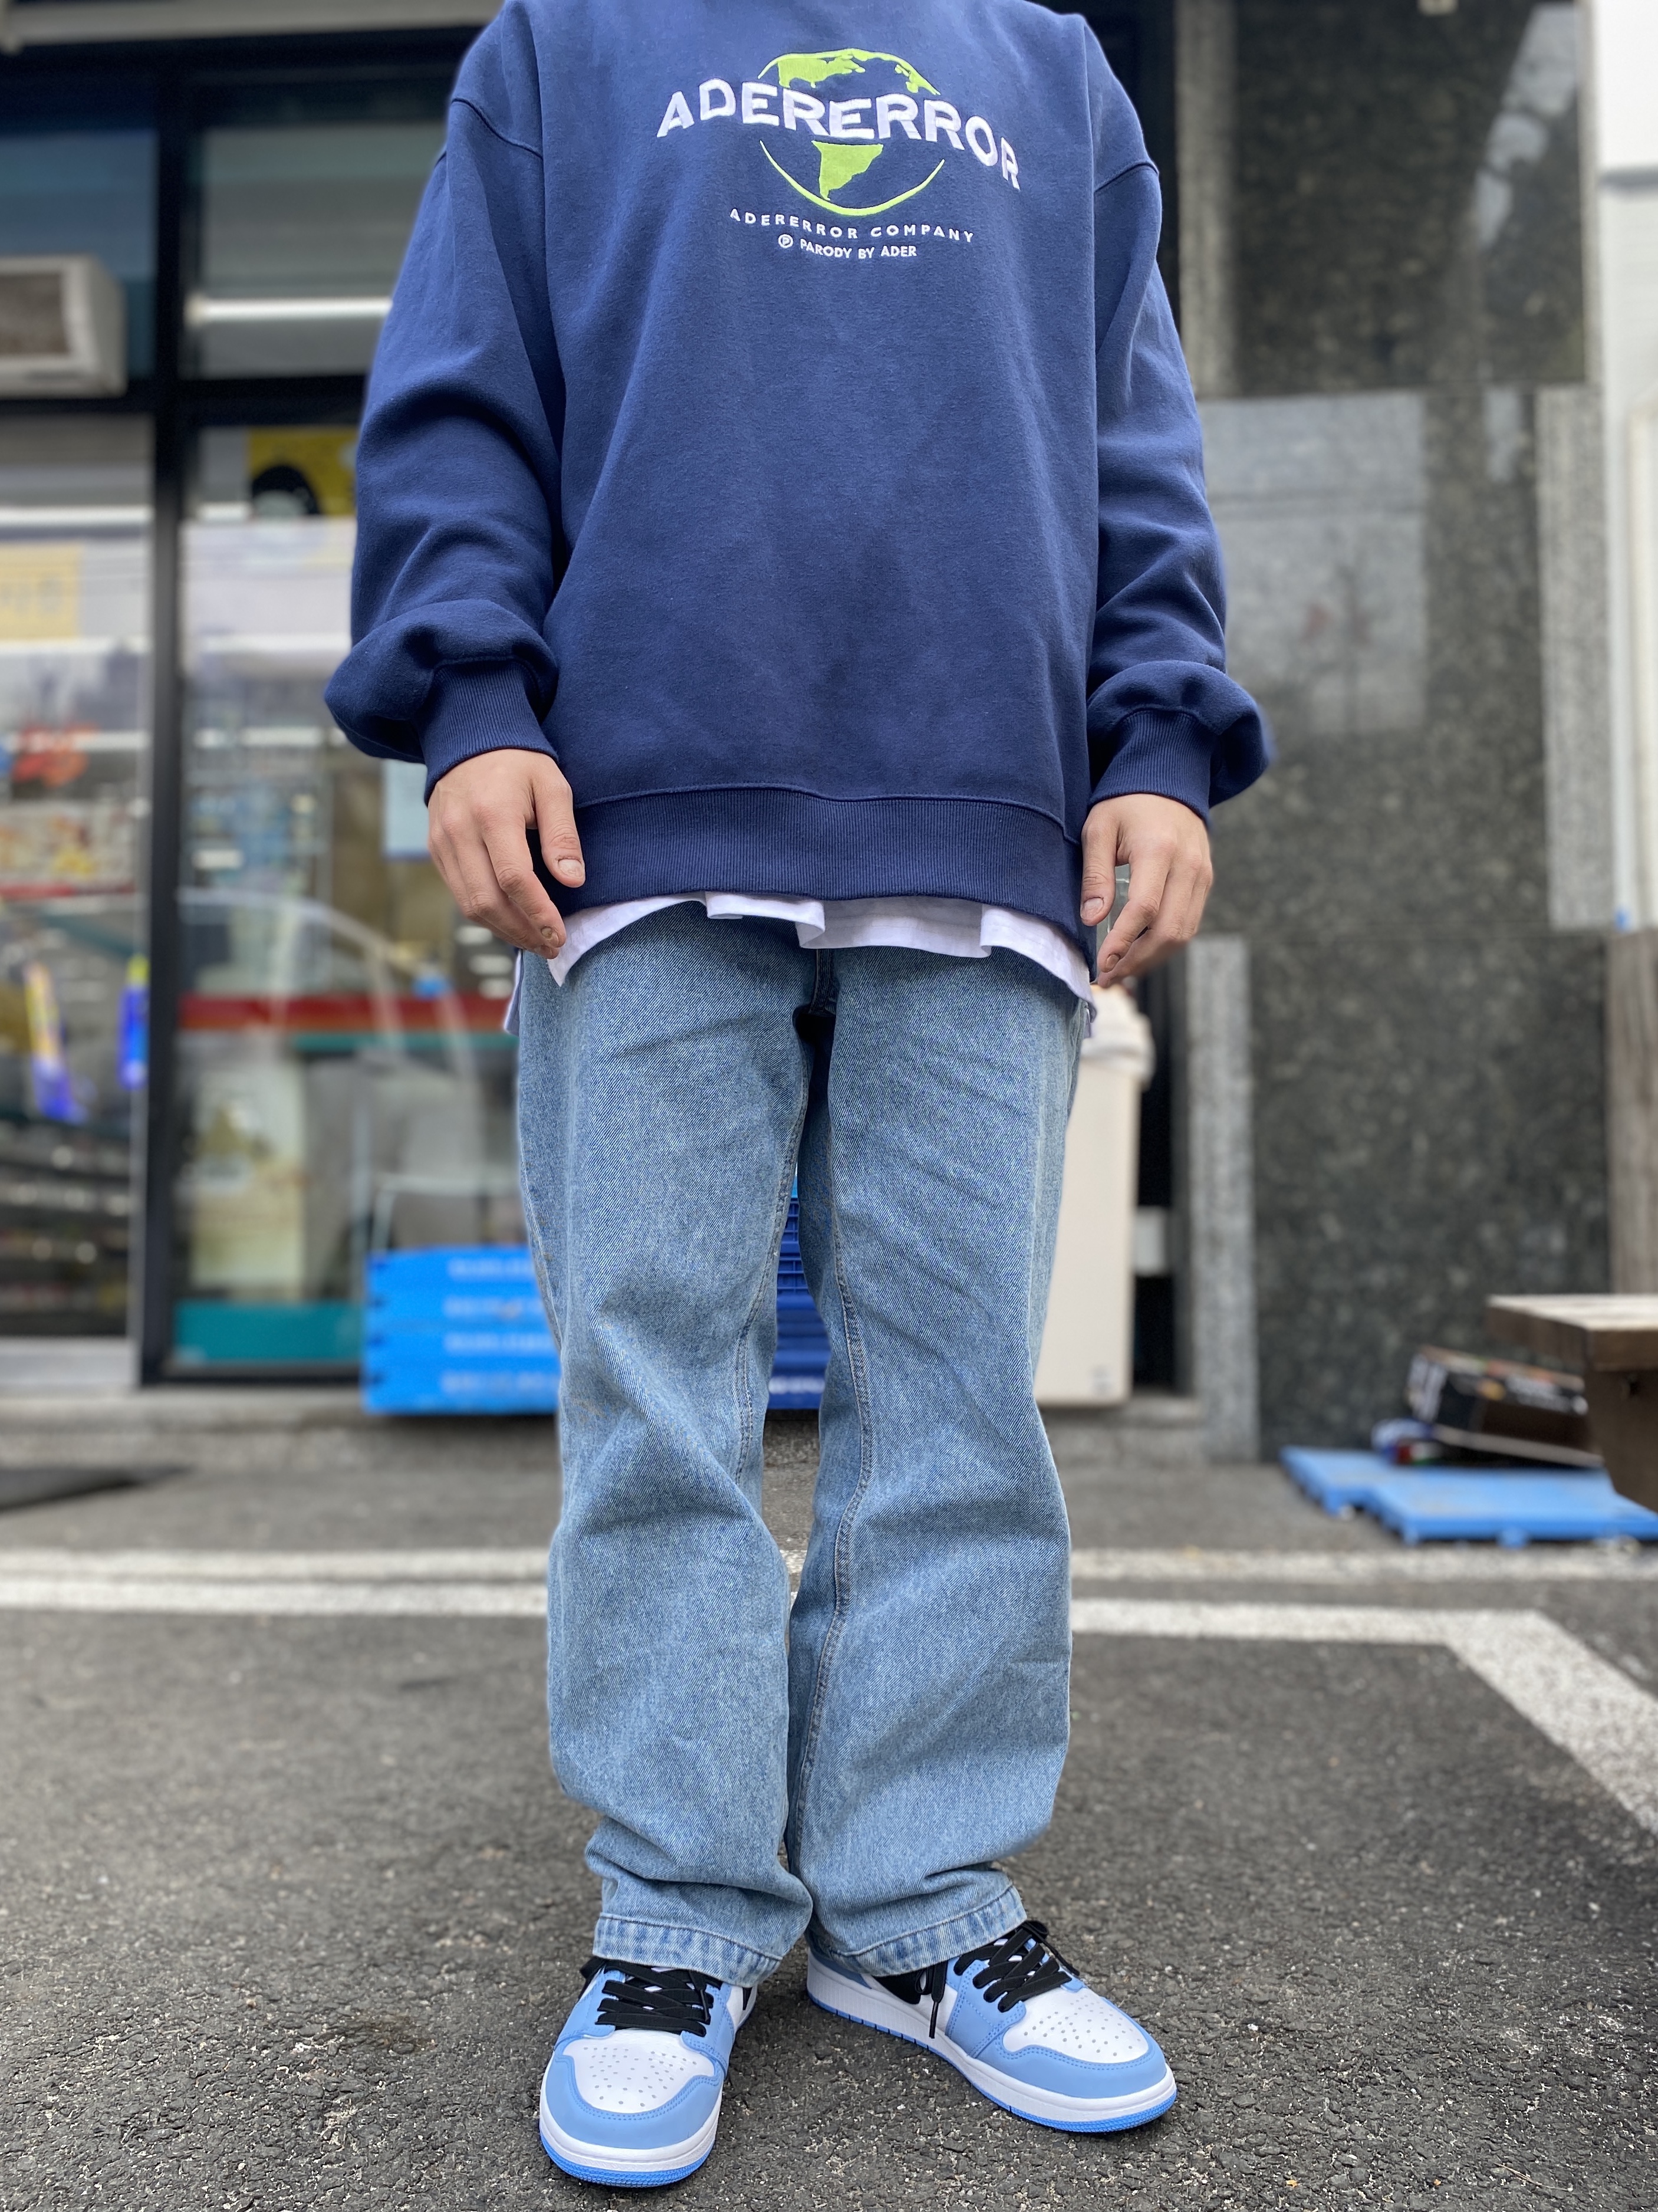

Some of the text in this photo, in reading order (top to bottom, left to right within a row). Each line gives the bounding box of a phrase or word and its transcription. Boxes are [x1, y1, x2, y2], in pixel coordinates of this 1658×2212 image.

[656, 77, 1021, 190] ADERERROR
[729, 208, 974, 243] ADERERROR COMPANY
[800, 238, 853, 259] PARODY
[858, 246, 876, 259] BY
[880, 245, 917, 258] ADER
